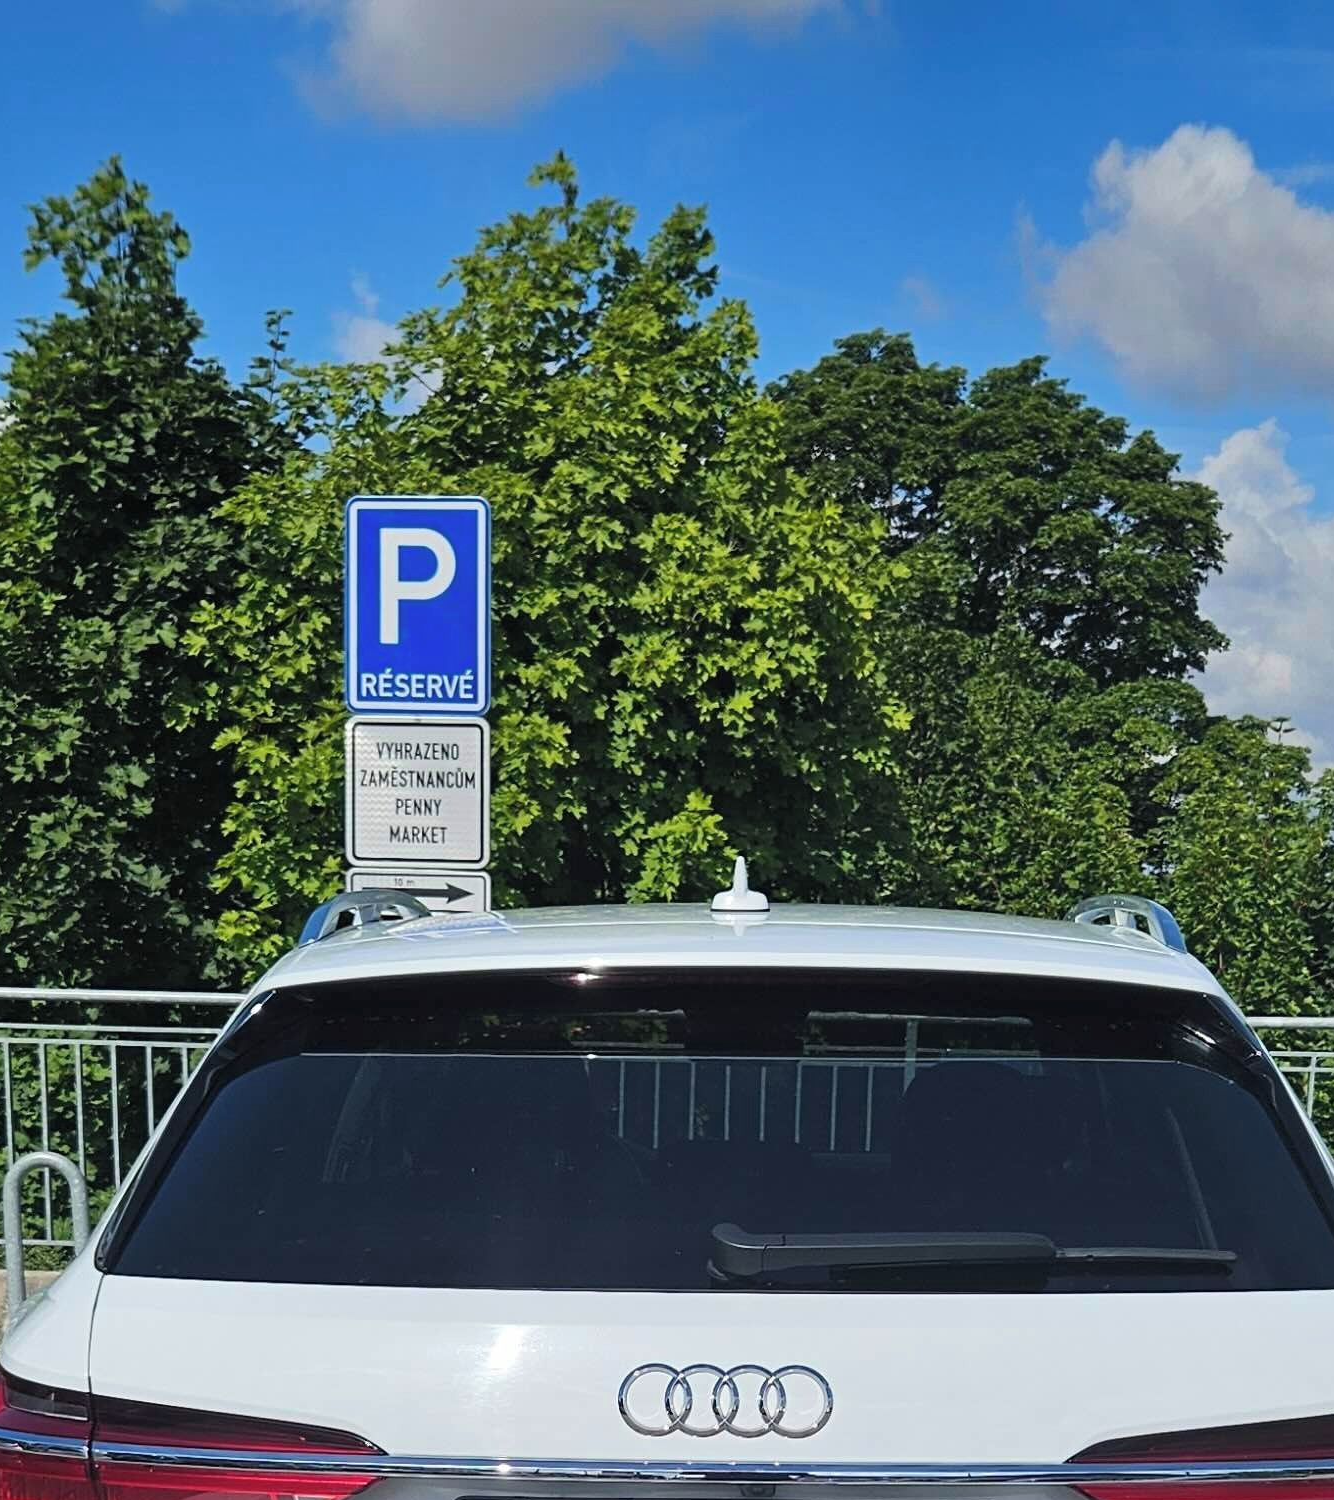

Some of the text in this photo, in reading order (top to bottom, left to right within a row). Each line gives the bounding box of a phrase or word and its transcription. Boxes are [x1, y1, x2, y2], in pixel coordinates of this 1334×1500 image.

[379, 527, 456, 645] P
[361, 668, 474, 699] RÉSERVÉ
[376, 742, 459, 760] VYHRAZENO
[360, 767, 475, 789] ZAMĚSTNANCŮM
[395, 798, 442, 816] PENNY
[389, 825, 447, 844] MARKET
